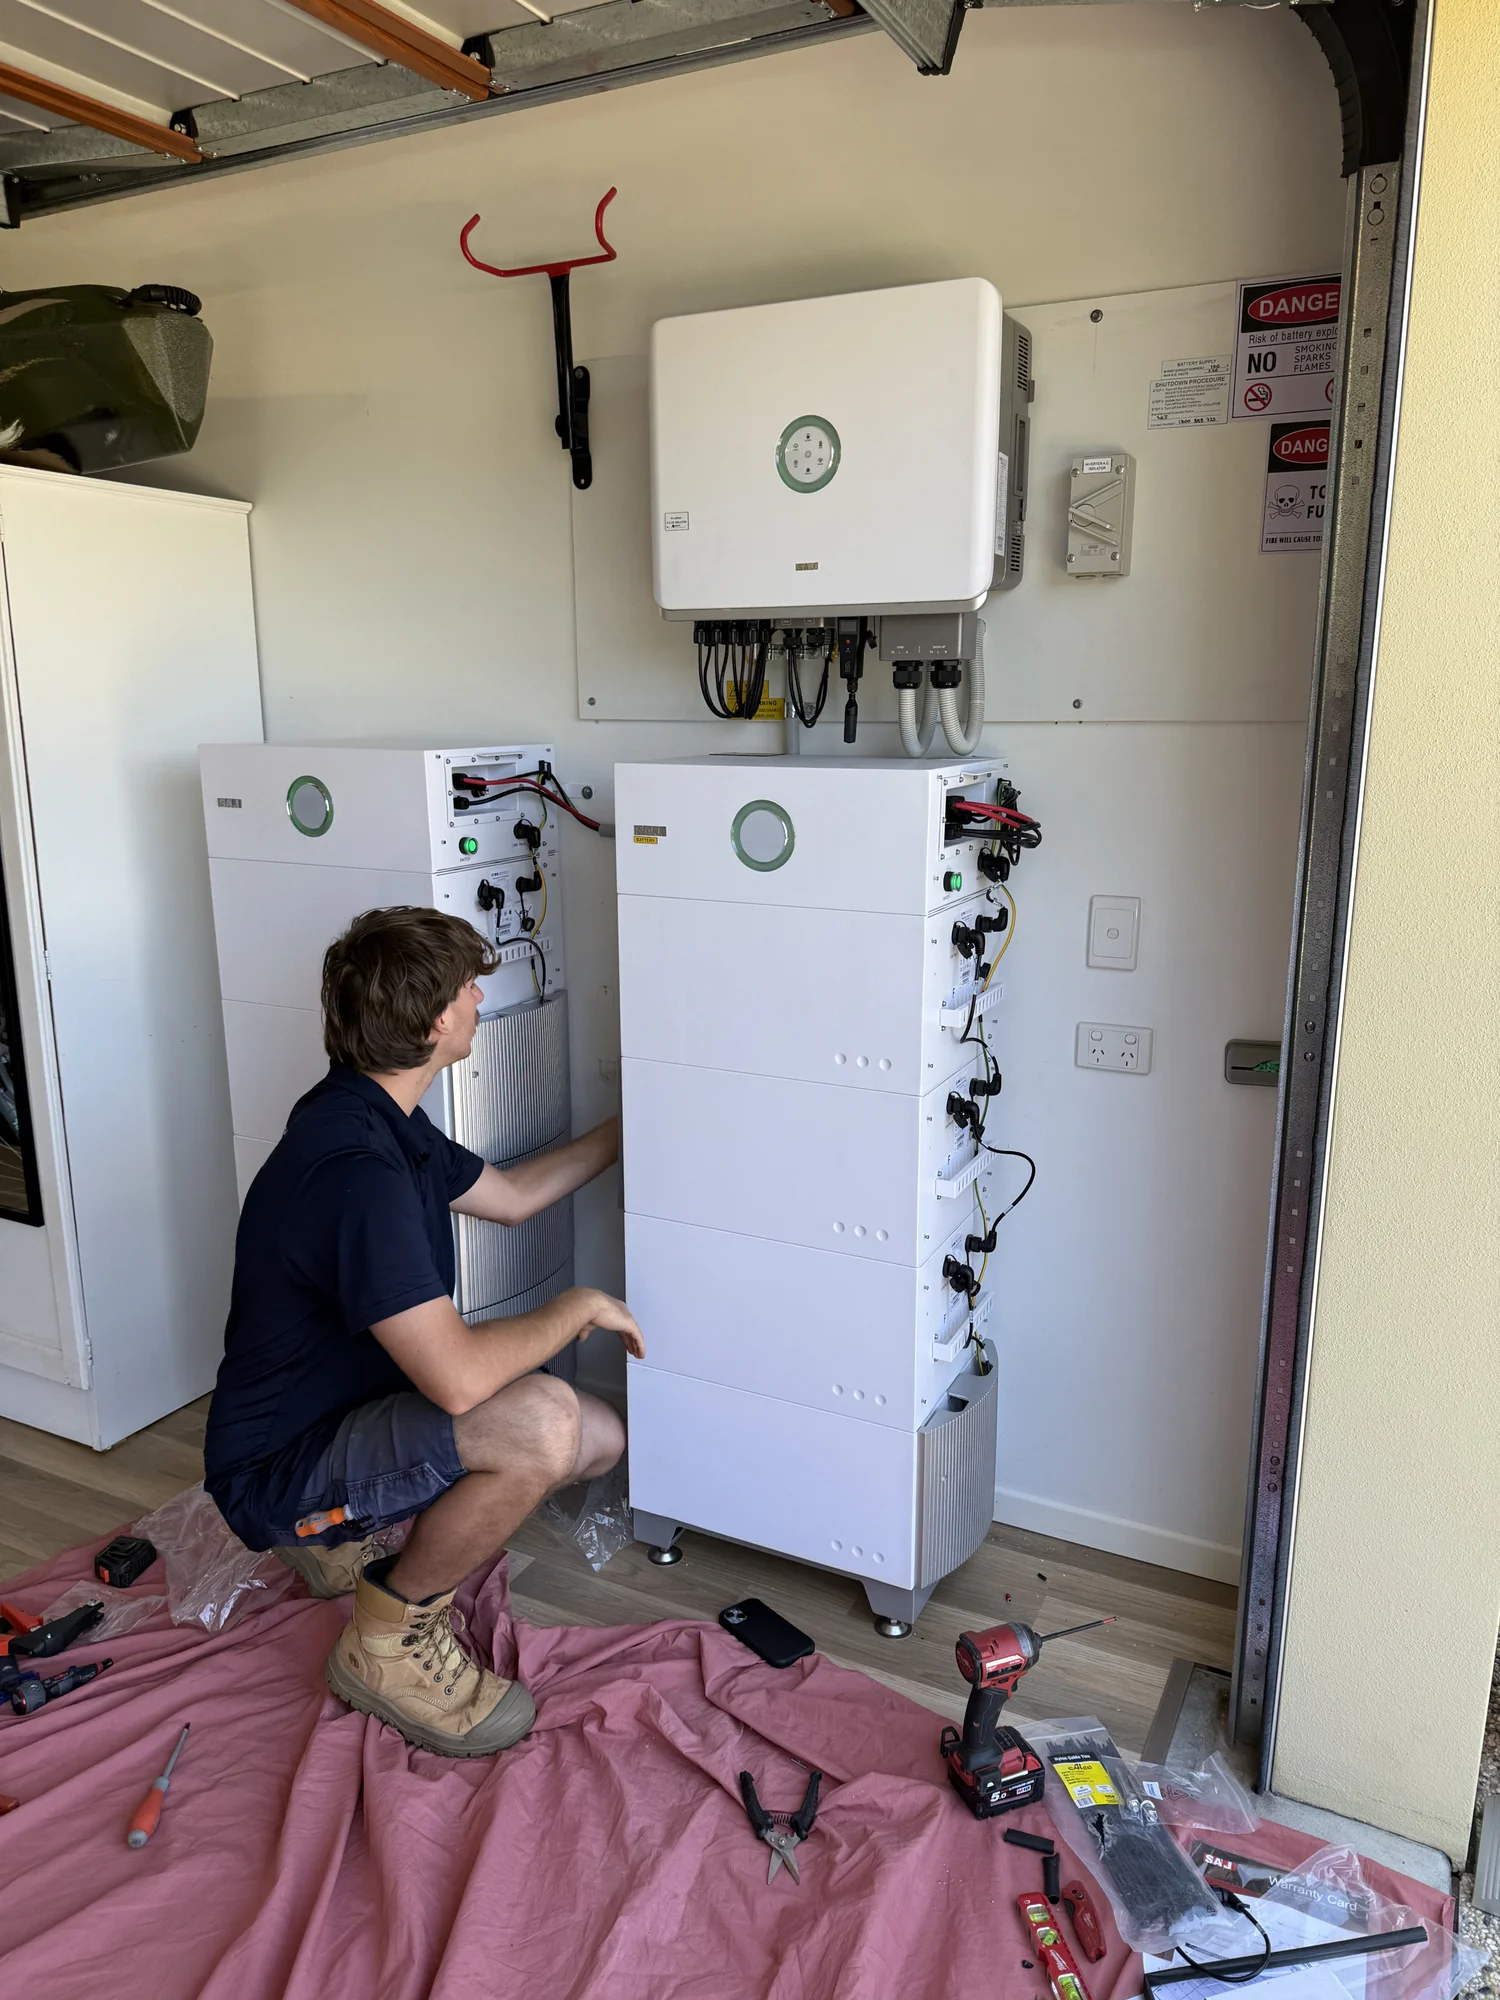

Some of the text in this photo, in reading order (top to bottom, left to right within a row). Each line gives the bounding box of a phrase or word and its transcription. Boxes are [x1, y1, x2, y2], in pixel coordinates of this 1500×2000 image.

[1259, 291, 1338, 317] DANGE
[1248, 326, 1338, 344] Risk of battery explo
[1294, 342, 1337, 354] SMOKING
[1248, 351, 1277, 374] NO
[1294, 352, 1331, 363] SPARKS
[1294, 362, 1331, 372] FLAMES
[1189, 376, 1225, 384] PROCEDURE
[1281, 438, 1328, 454] DANG
[1310, 484, 1326, 499] TO
[1307, 506, 1324, 518] FU
[990, 1791, 1007, 1802] 5.0
[1204, 1853, 1234, 1870] SAJ
[1268, 1876, 1358, 1911] Warranty Card
